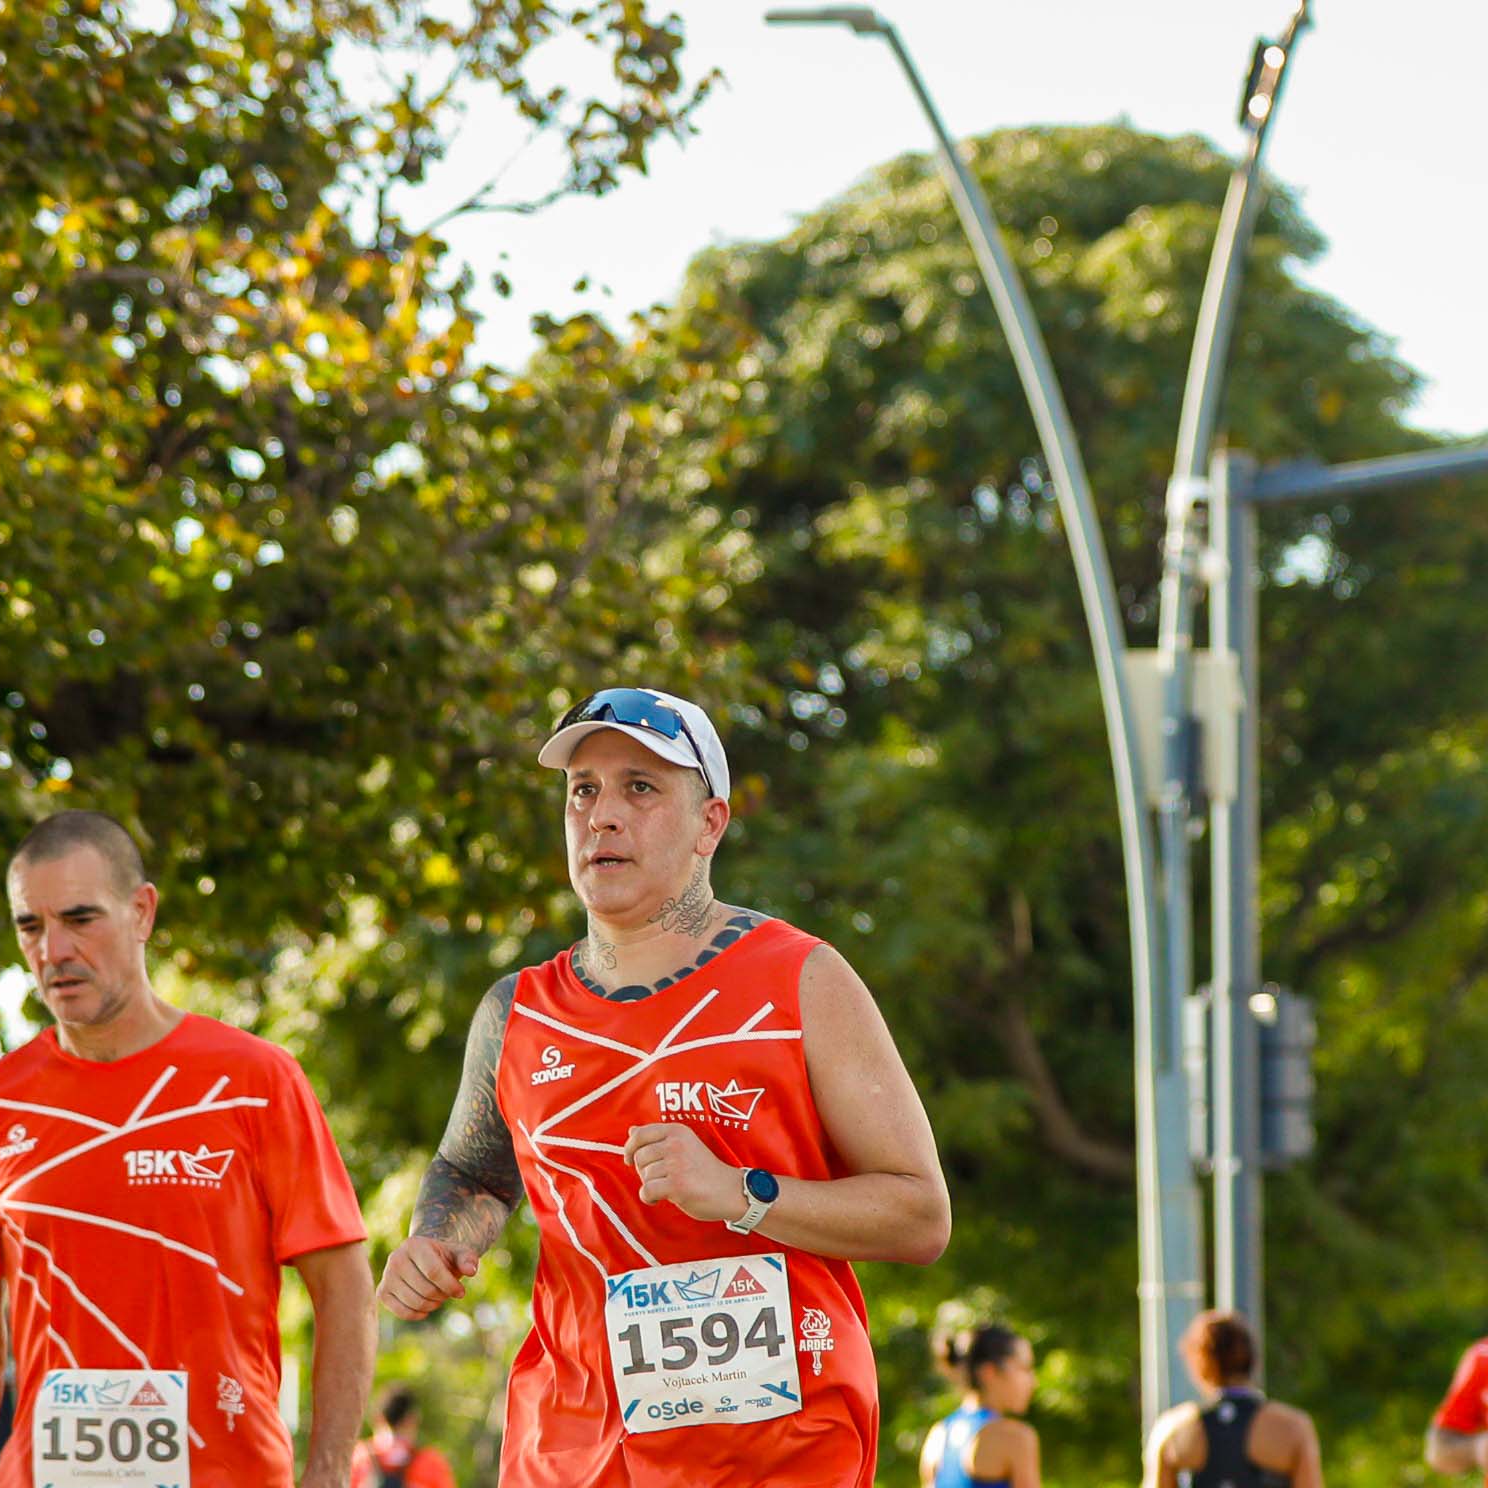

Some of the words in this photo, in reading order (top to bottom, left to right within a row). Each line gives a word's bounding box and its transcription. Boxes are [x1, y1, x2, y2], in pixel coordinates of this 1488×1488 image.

[655, 1082, 704, 1112] 15K
[123, 1150, 178, 1177] 15K
[622, 1280, 672, 1309] 15K
[730, 1279, 757, 1294] 15K
[618, 1306, 786, 1375] 1594
[799, 1339, 834, 1351] ARDEC
[712, 1369, 747, 1382] Martin
[52, 1383, 89, 1403] 15K
[140, 1391, 159, 1403] 15K
[648, 1397, 704, 1420] osde
[42, 1416, 180, 1462] 1508
